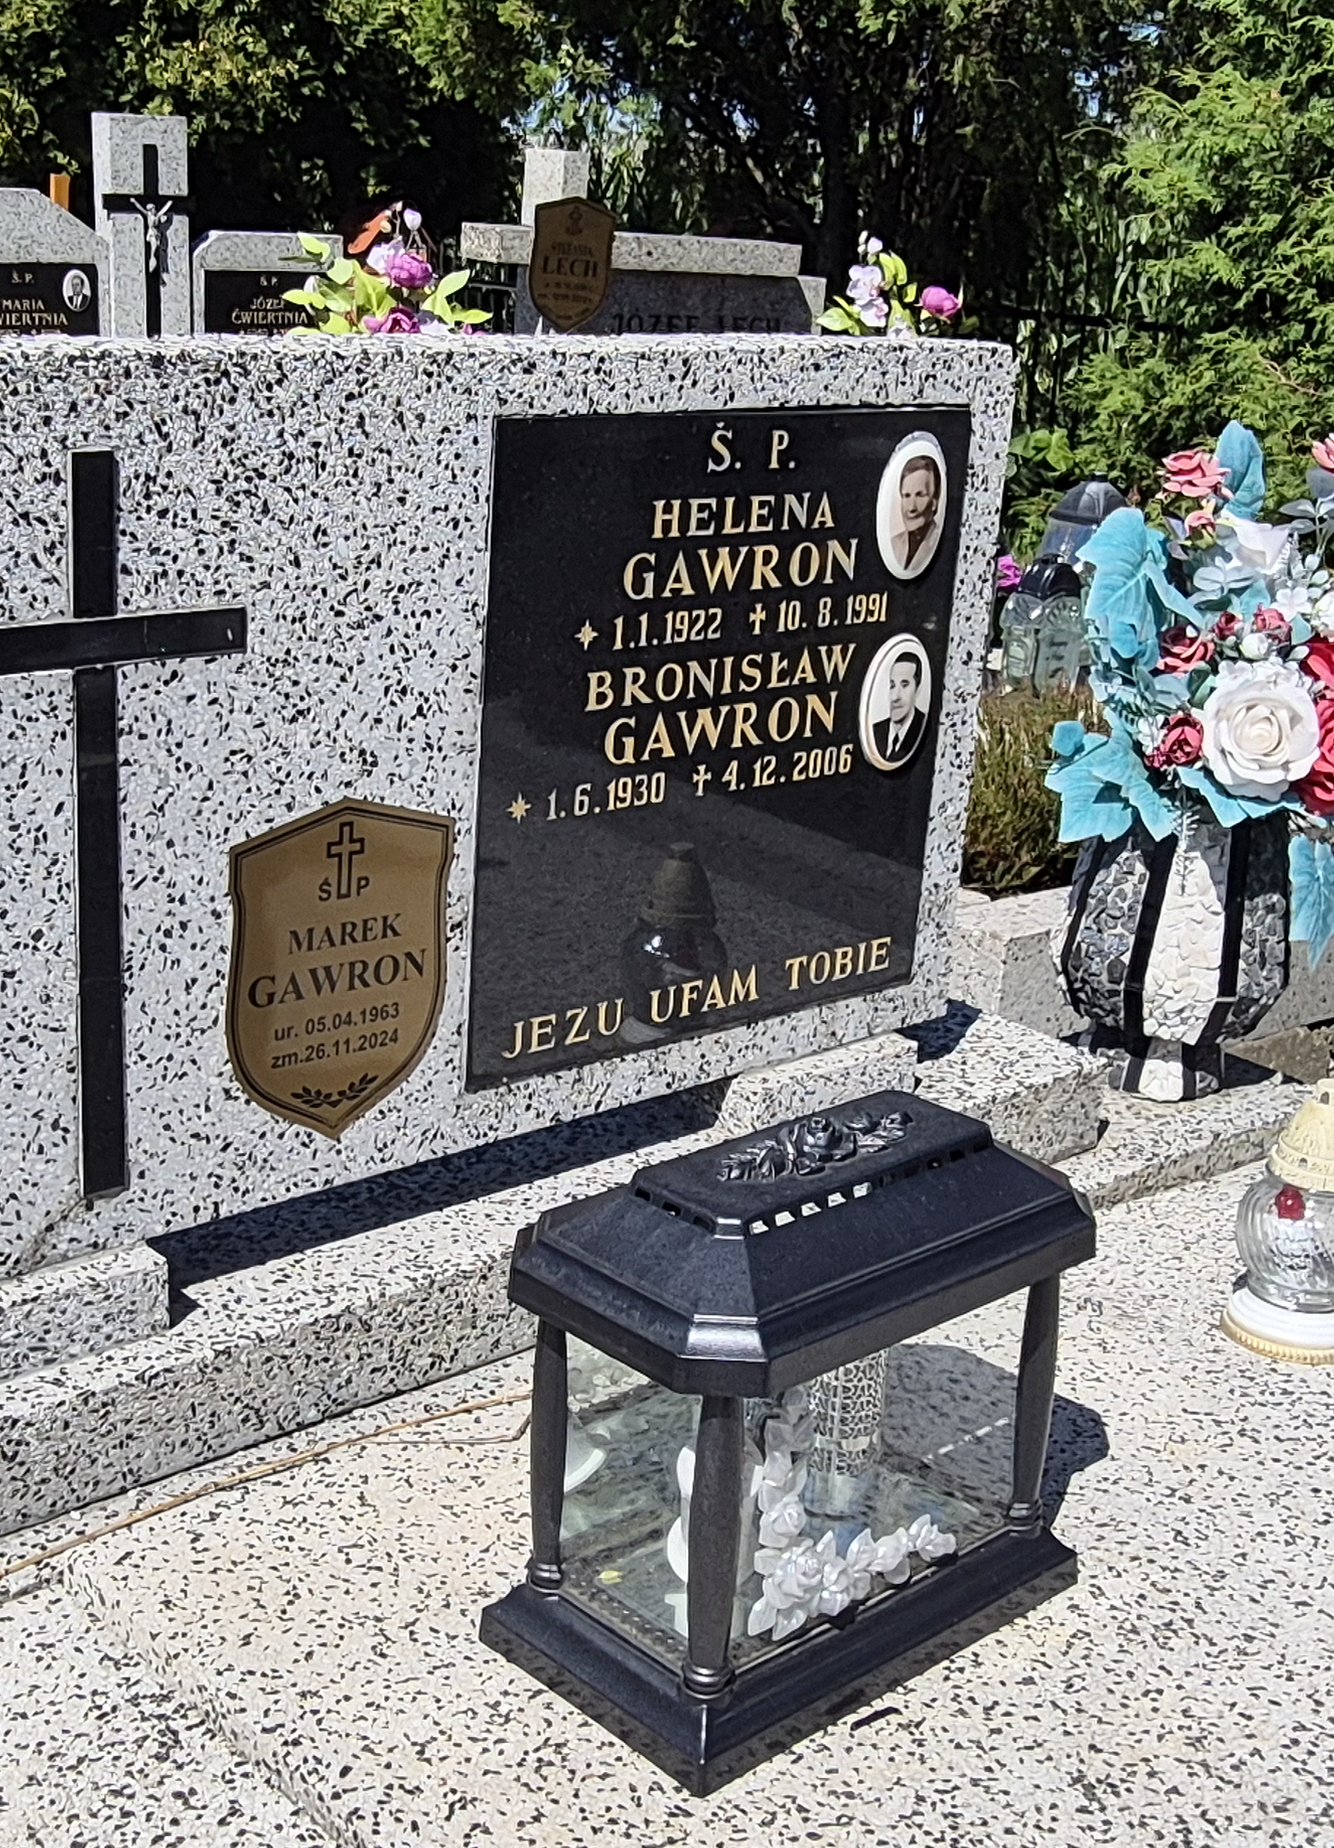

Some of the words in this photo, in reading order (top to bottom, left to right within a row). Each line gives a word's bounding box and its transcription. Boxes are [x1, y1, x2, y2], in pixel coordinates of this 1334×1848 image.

[542, 256, 599, 278] LECH
[2, 299, 45, 311] MARIA
[231, 308, 308, 325] ĆWIERTNIA
[706, 422, 742, 474] Ś.
[768, 429, 796, 470] P.
[651, 491, 835, 540] HELENA
[623, 538, 858, 601] GAWRON
[612, 608, 723, 651] 1.1.1922
[584, 643, 857, 712] BRONISŁAW
[604, 690, 840, 766] GAWRON
[356, 876, 371, 897] P
[287, 912, 402, 956] MAREK
[247, 949, 428, 1009] GAWRON
[501, 997, 626, 1060] JEZU
[649, 964, 760, 1024] UFAM
[785, 936, 893, 991] TOBIE
[273, 1023, 299, 1042] ur.
[305, 1001, 400, 1037] 05.04.1963
